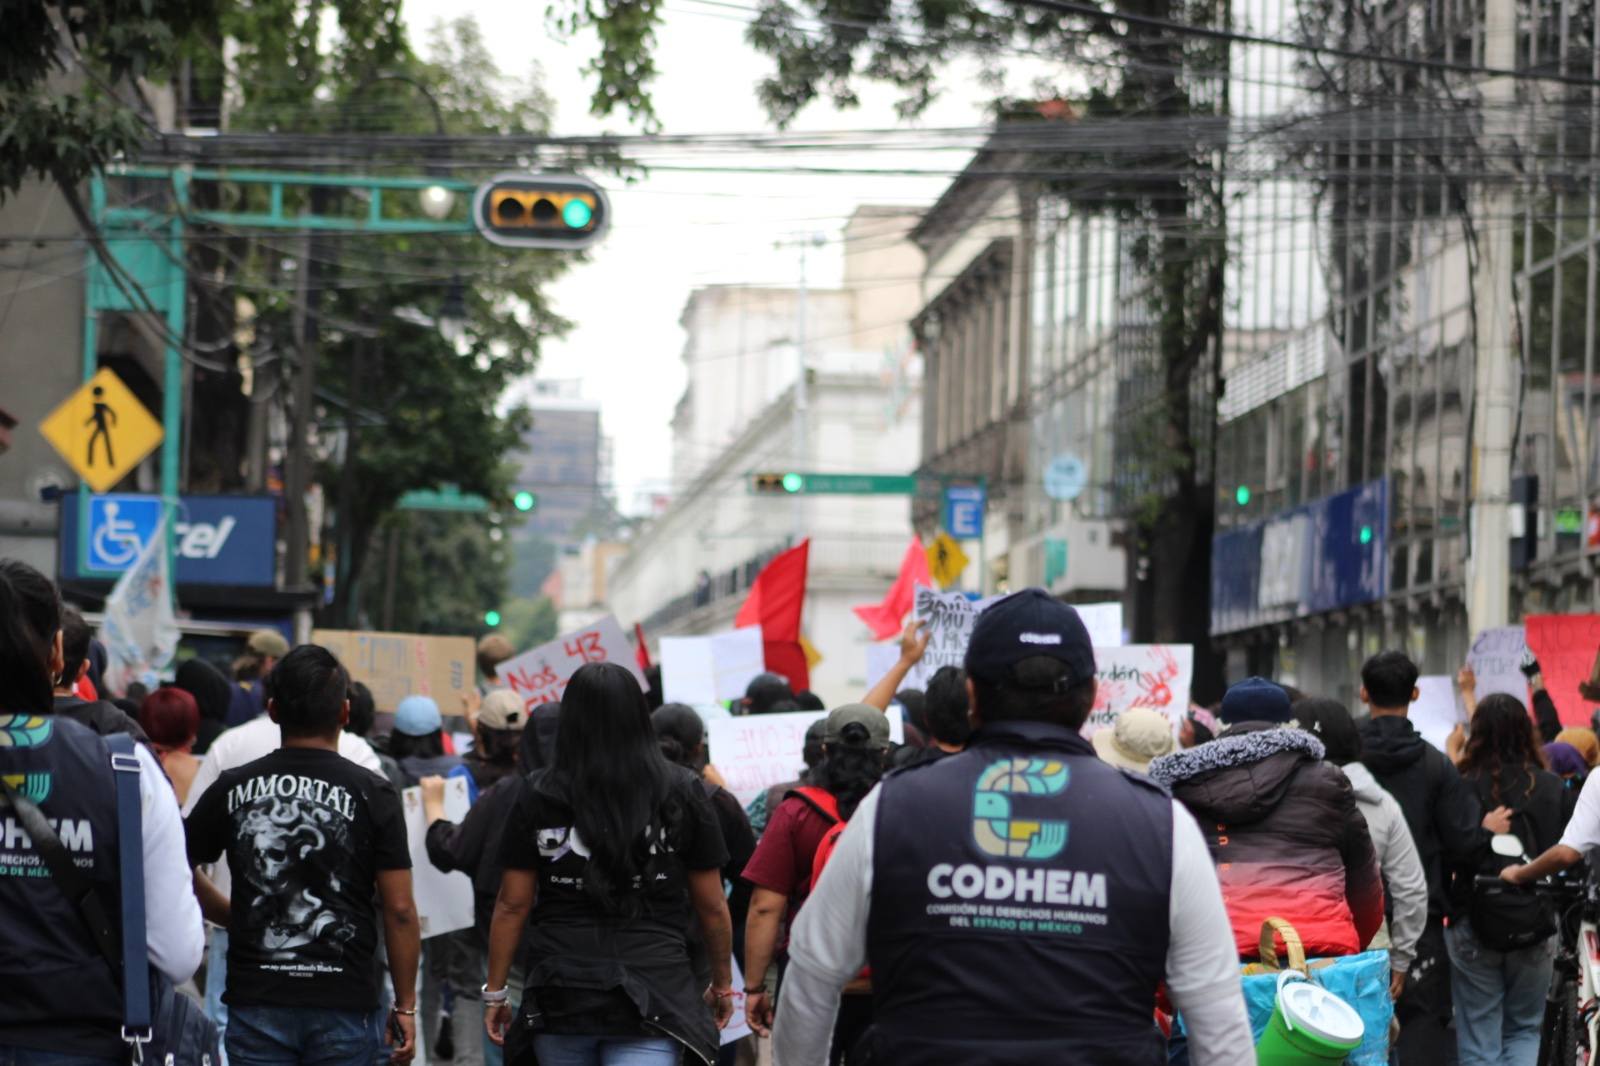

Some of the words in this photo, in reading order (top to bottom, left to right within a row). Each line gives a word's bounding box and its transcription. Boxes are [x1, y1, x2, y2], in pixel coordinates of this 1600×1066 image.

[954, 503, 976, 534] E
[563, 630, 608, 664] 43
[1096, 663, 1141, 683] rdón
[228, 774, 356, 821] IMMORTAL
[27, 867, 52, 877] MÉX
[927, 863, 1107, 908] CODHEM
[926, 903, 978, 915] COMISIÓN
[979, 906, 994, 917] DE
[996, 906, 1052, 920] DERECHOS
[1053, 909, 1108, 925] HUMANOS
[950, 917, 970, 928] DEL
[973, 917, 1017, 931] ESTADO
[1019, 920, 1034, 931] DE
[1037, 920, 1083, 934] MÉXICO
